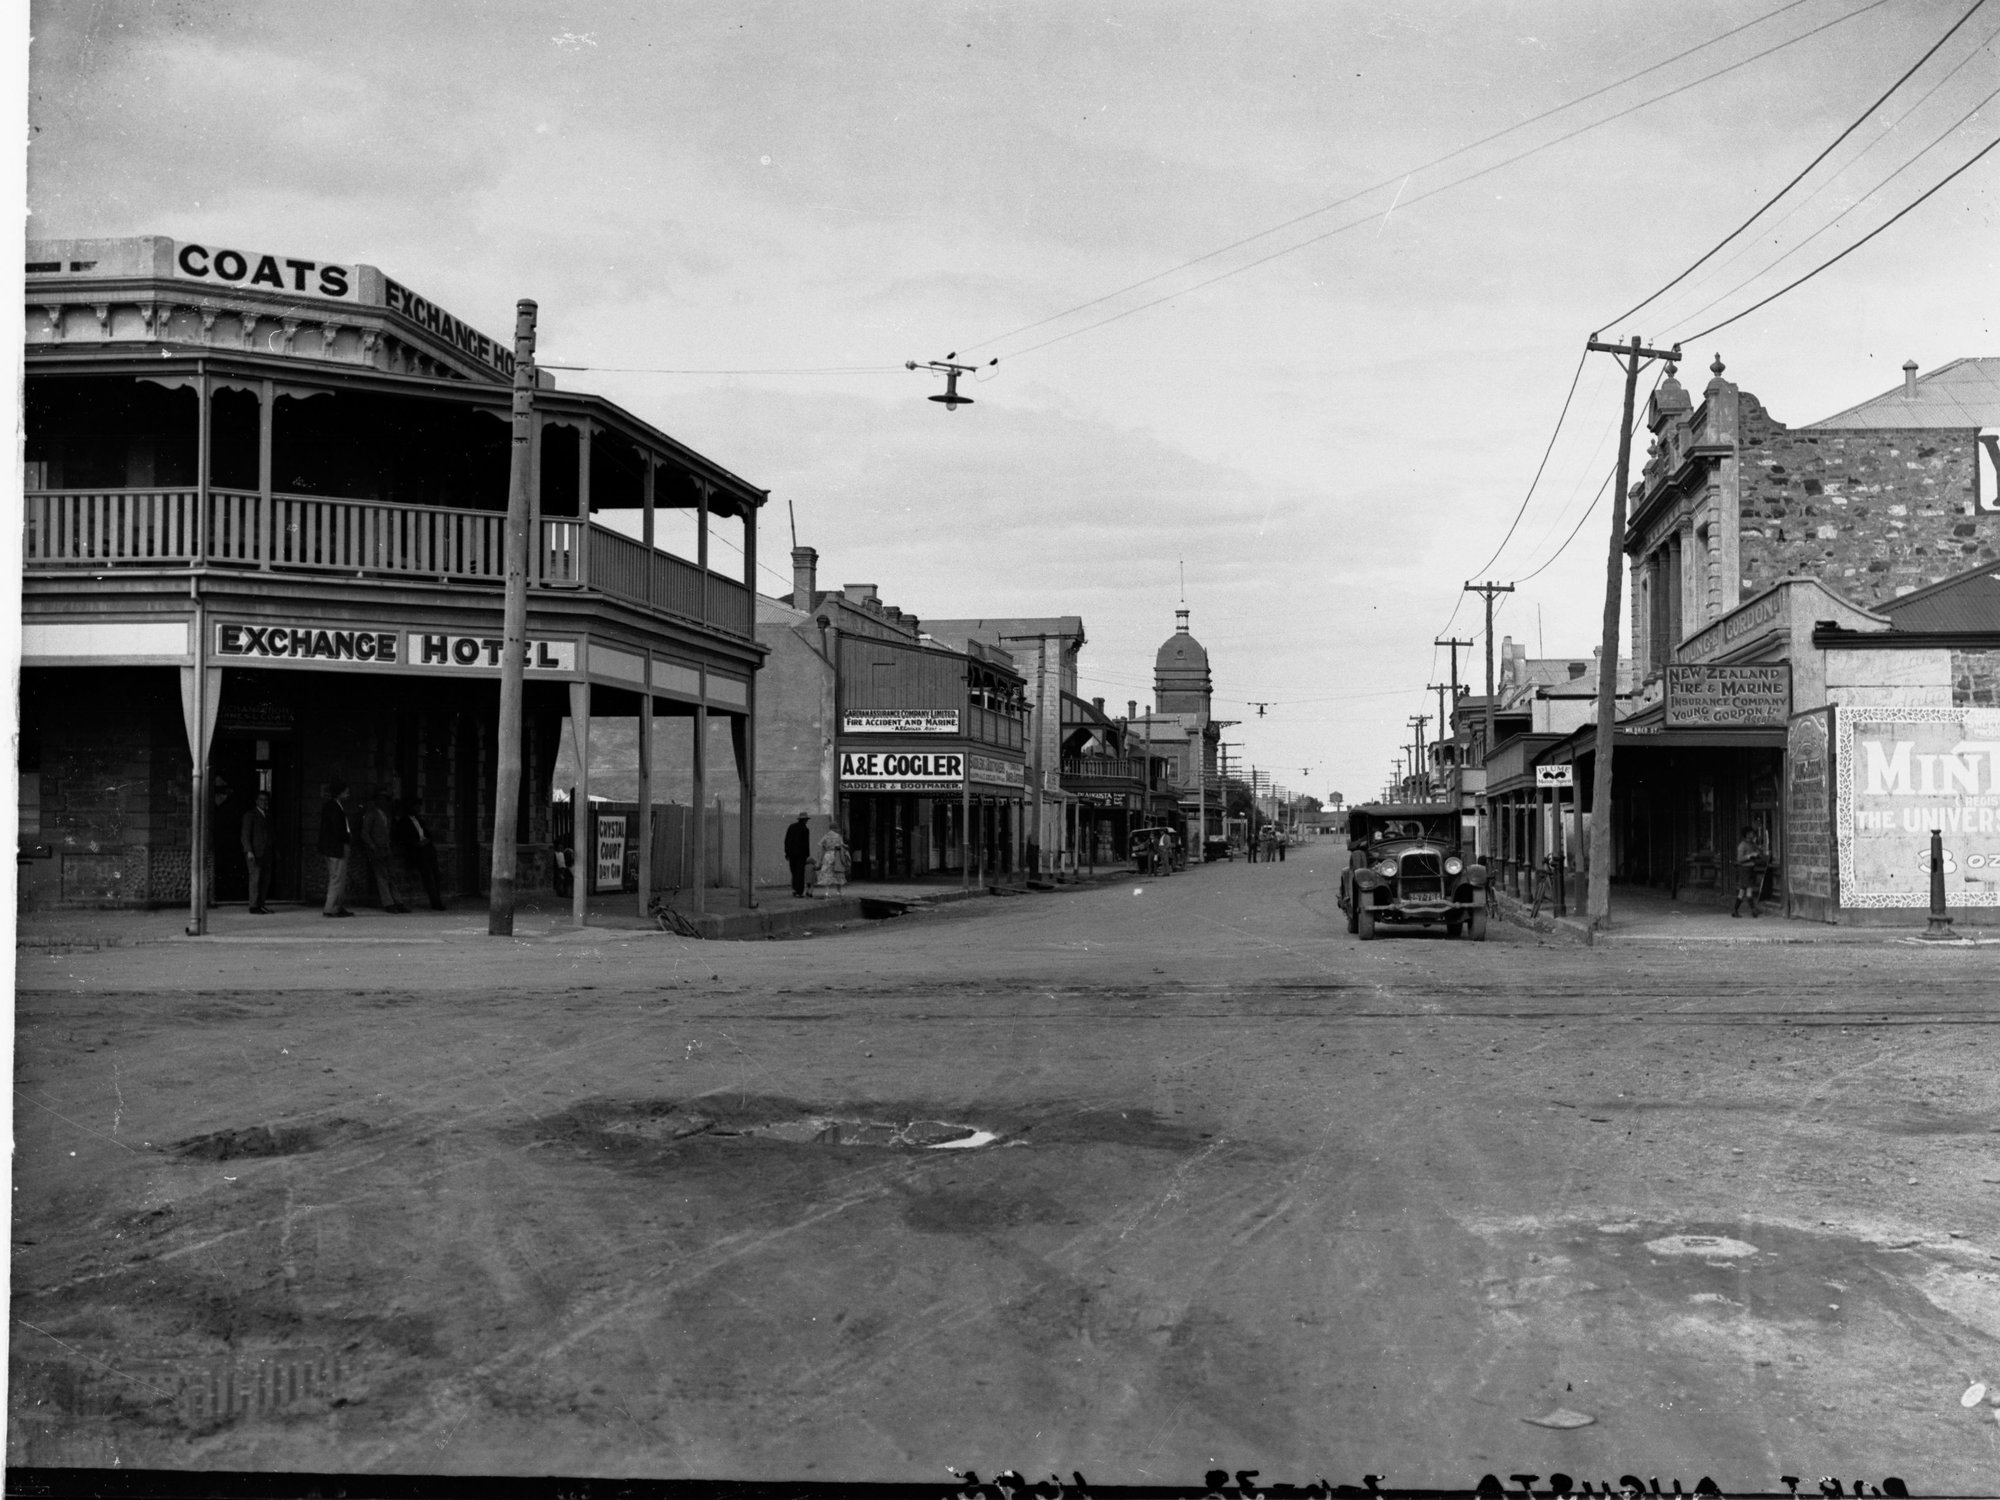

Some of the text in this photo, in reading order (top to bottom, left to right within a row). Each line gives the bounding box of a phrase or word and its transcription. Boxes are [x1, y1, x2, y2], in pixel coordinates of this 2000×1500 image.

[178, 244, 350, 298] COATS
[385, 278, 490, 365] EXCHANGE
[1726, 598, 1775, 640] GORDON
[218, 624, 397, 662] EXCHANGE
[1669, 667, 1780, 681] NEW ZEALAND
[1670, 681, 1783, 696] FIRE & MARINE
[1671, 696, 1787, 708] INSURANCE COMPANY
[901, 709, 930, 719] COMPANY
[1672, 706, 1709, 720] YOUNG
[1713, 707, 1763, 721] GORDON
[1538, 766, 1571, 774] PLUME
[841, 782, 887, 790] SADDLER
[900, 782, 962, 790] BOOTMAKER.
[1855, 806, 2000, 833] THE UNIVER
[600, 819, 625, 838] CRYSTAL
[601, 841, 621, 860] COURT
